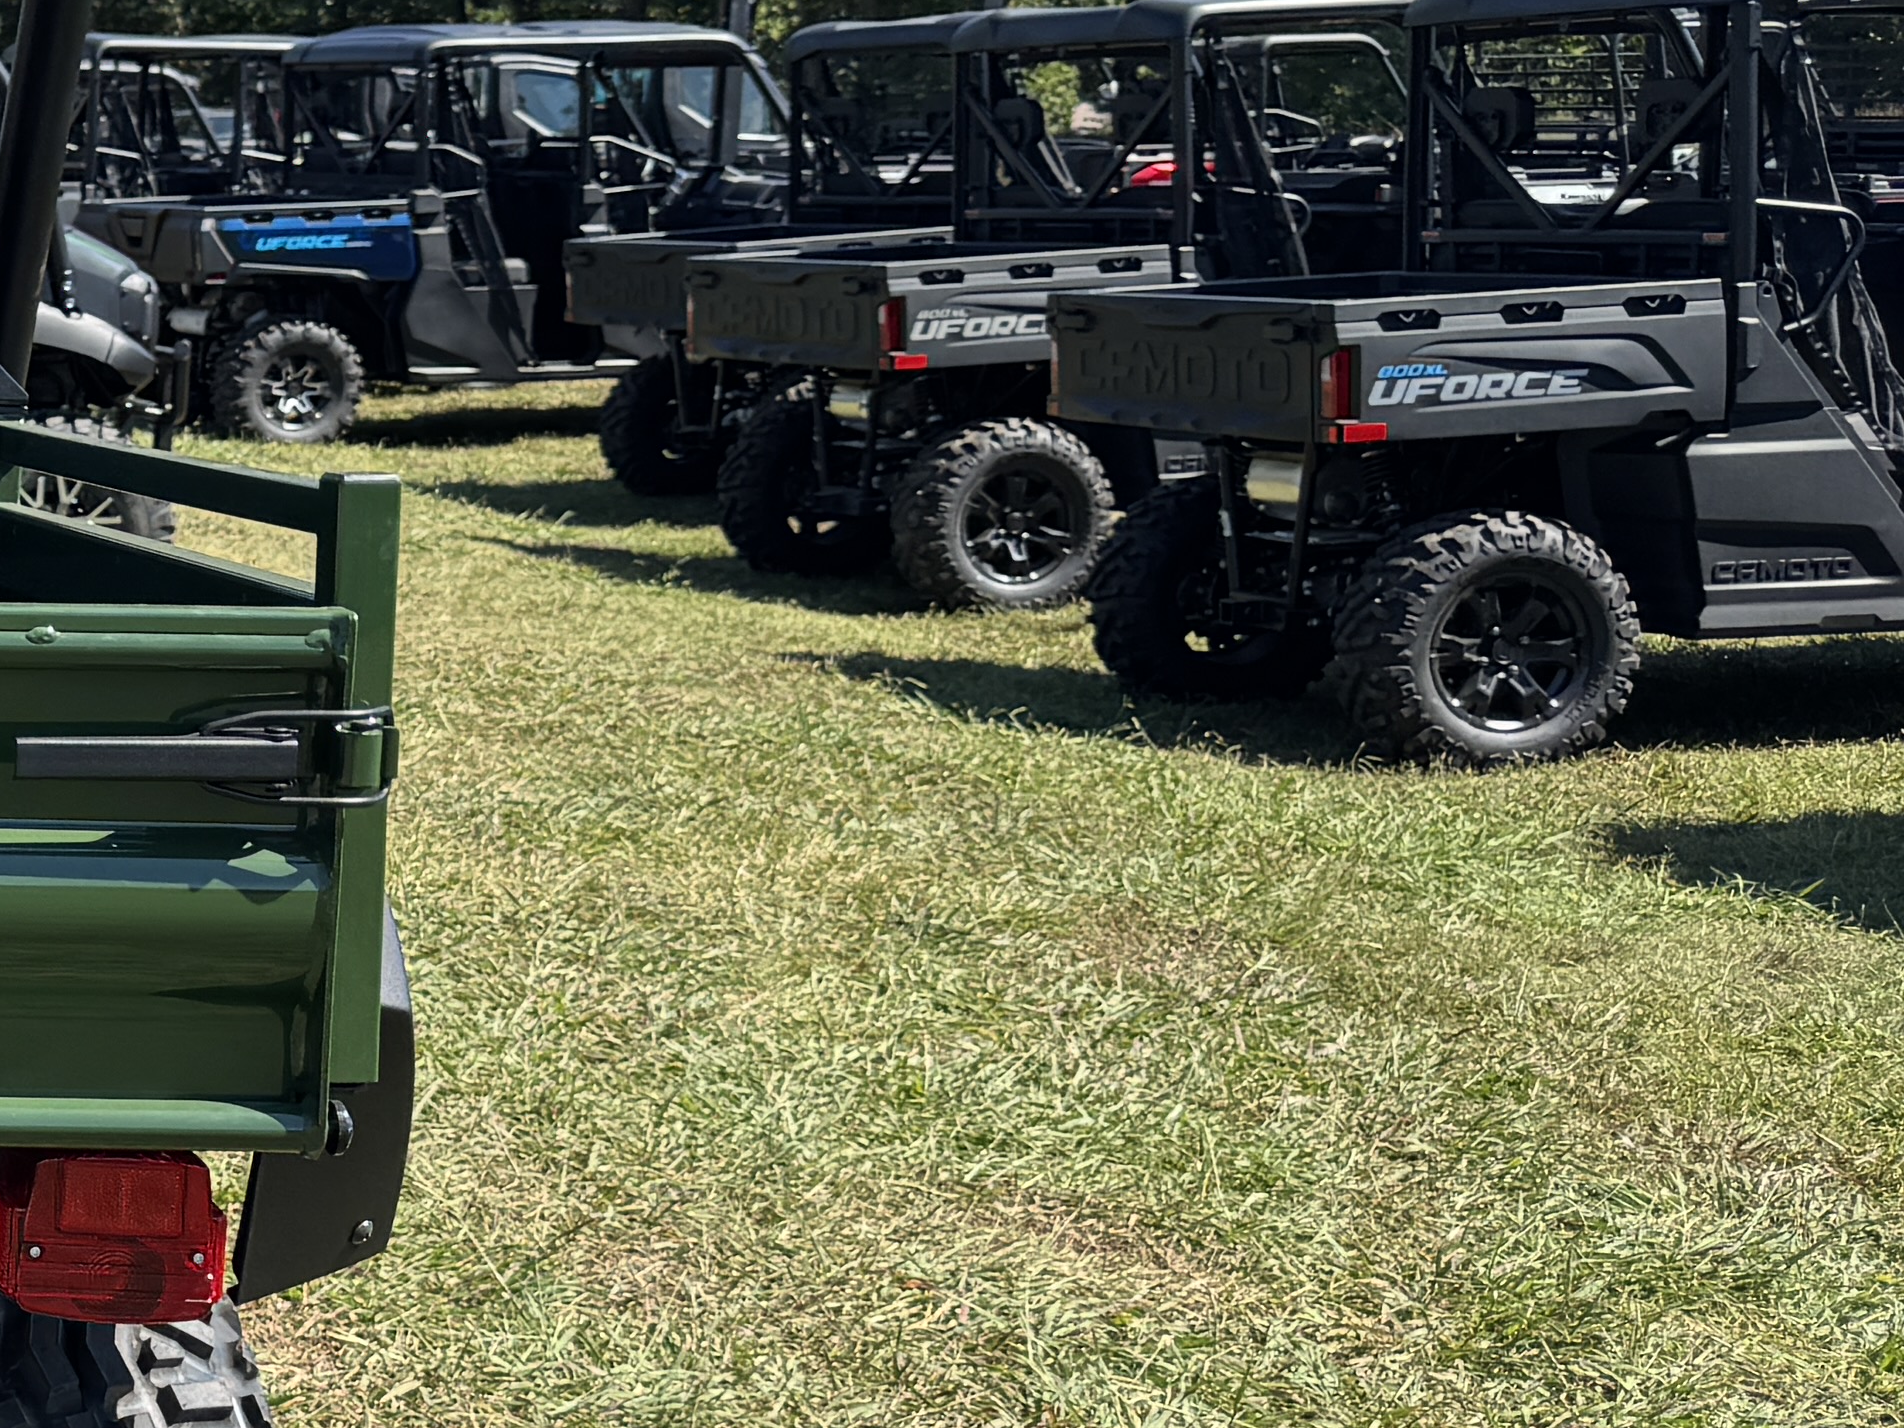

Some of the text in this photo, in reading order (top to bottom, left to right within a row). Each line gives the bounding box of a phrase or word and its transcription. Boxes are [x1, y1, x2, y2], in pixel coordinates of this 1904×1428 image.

[255, 234, 349, 252] UFORCE
[910, 314, 1047, 341] UFORC
[1367, 368, 1590, 407] UFORCE
